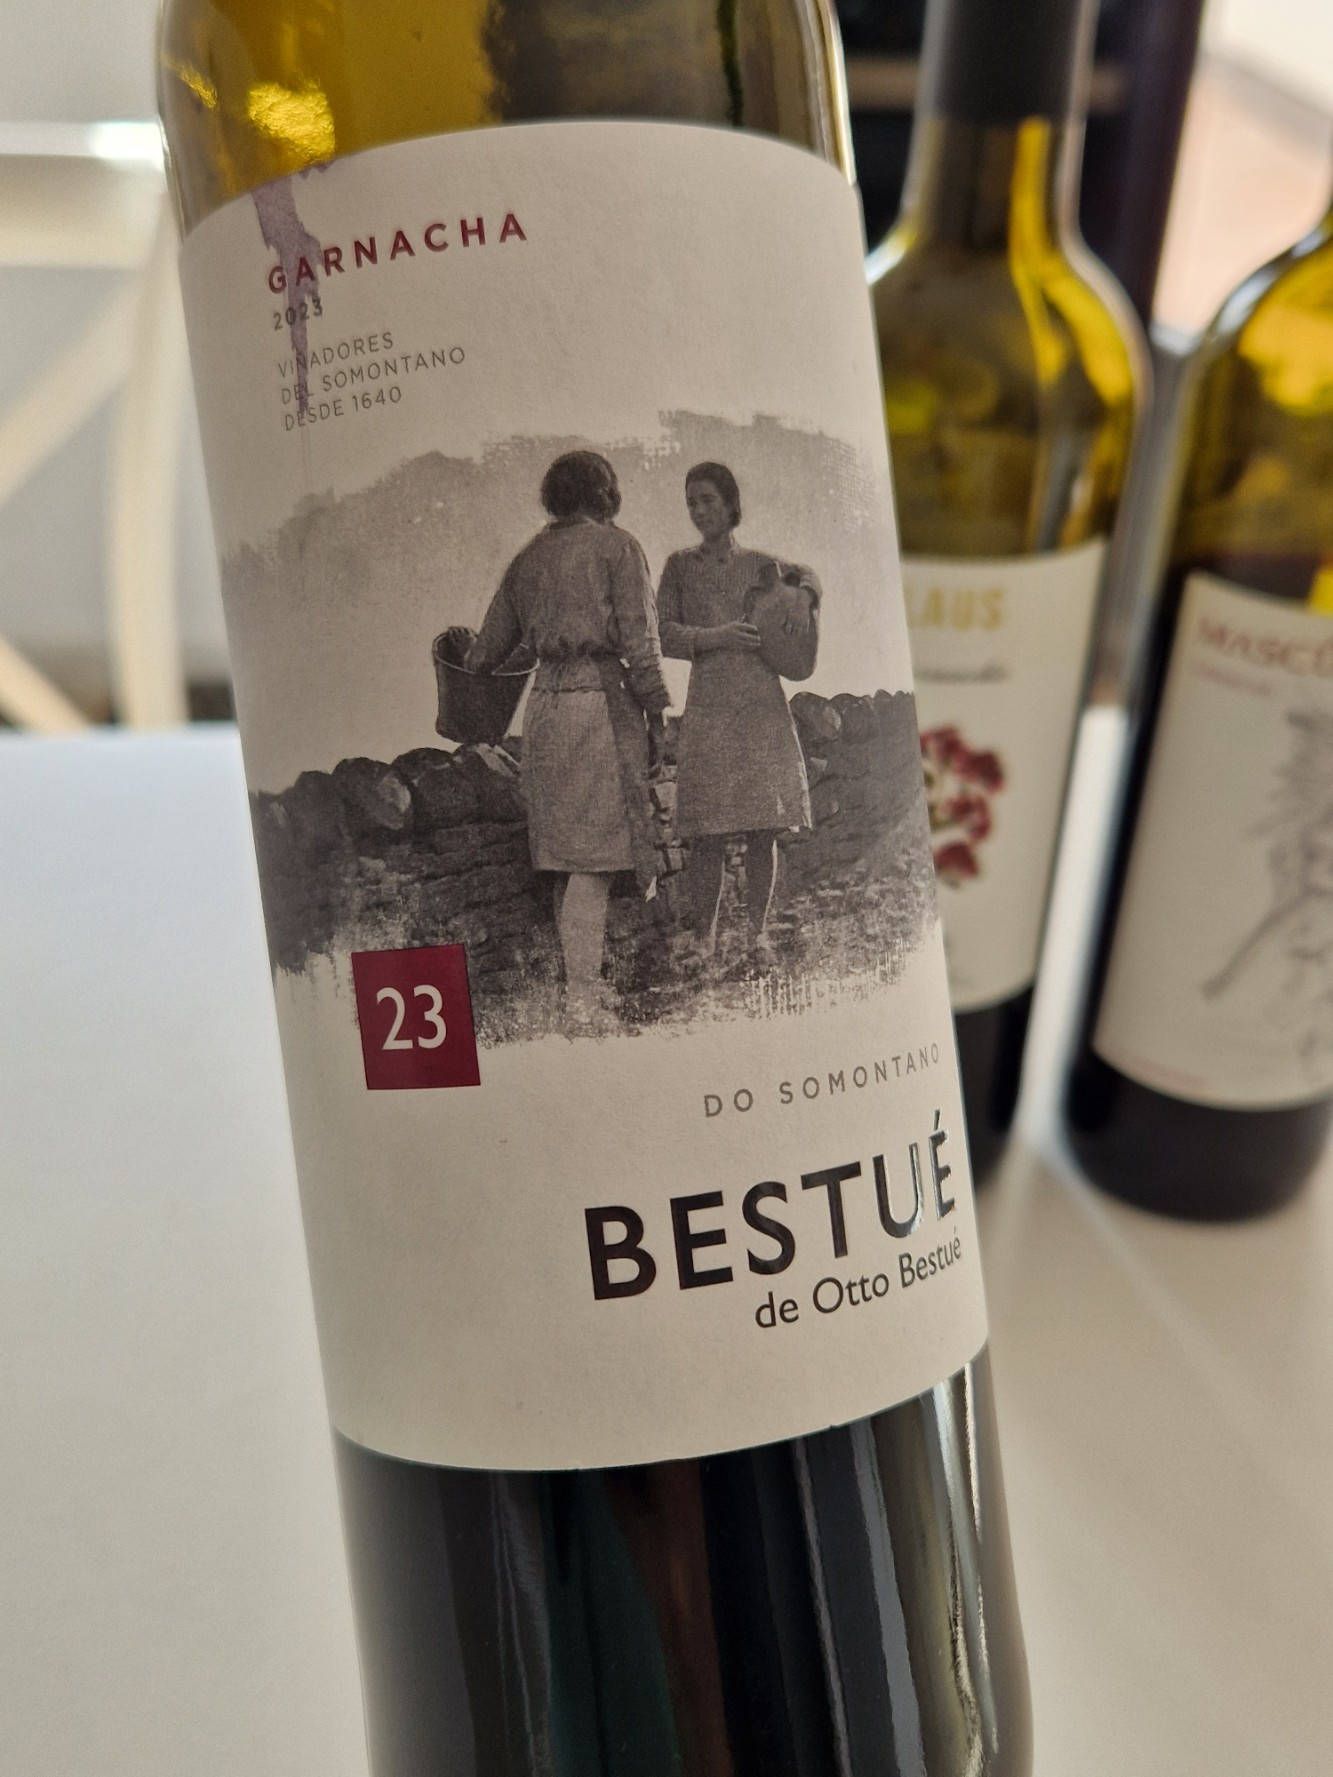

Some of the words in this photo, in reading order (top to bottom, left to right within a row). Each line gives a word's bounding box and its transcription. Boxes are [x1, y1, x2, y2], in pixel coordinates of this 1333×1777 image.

[268, 213, 527, 294] GARNACHA
[273, 298, 323, 331] 2023
[281, 382, 315, 405] DEL
[322, 346, 465, 392] SOMONTANO
[285, 399, 345, 431] DESDE
[352, 386, 402, 412] 1640
[376, 984, 447, 1051] 23
[704, 1088, 754, 1118] DO
[779, 1042, 940, 1105] SOMONTANO
[584, 1108, 956, 1301] BESTUÉ
[755, 1291, 799, 1329] de
[812, 1272, 890, 1315] Otto
[899, 1226, 962, 1289] Bestué
